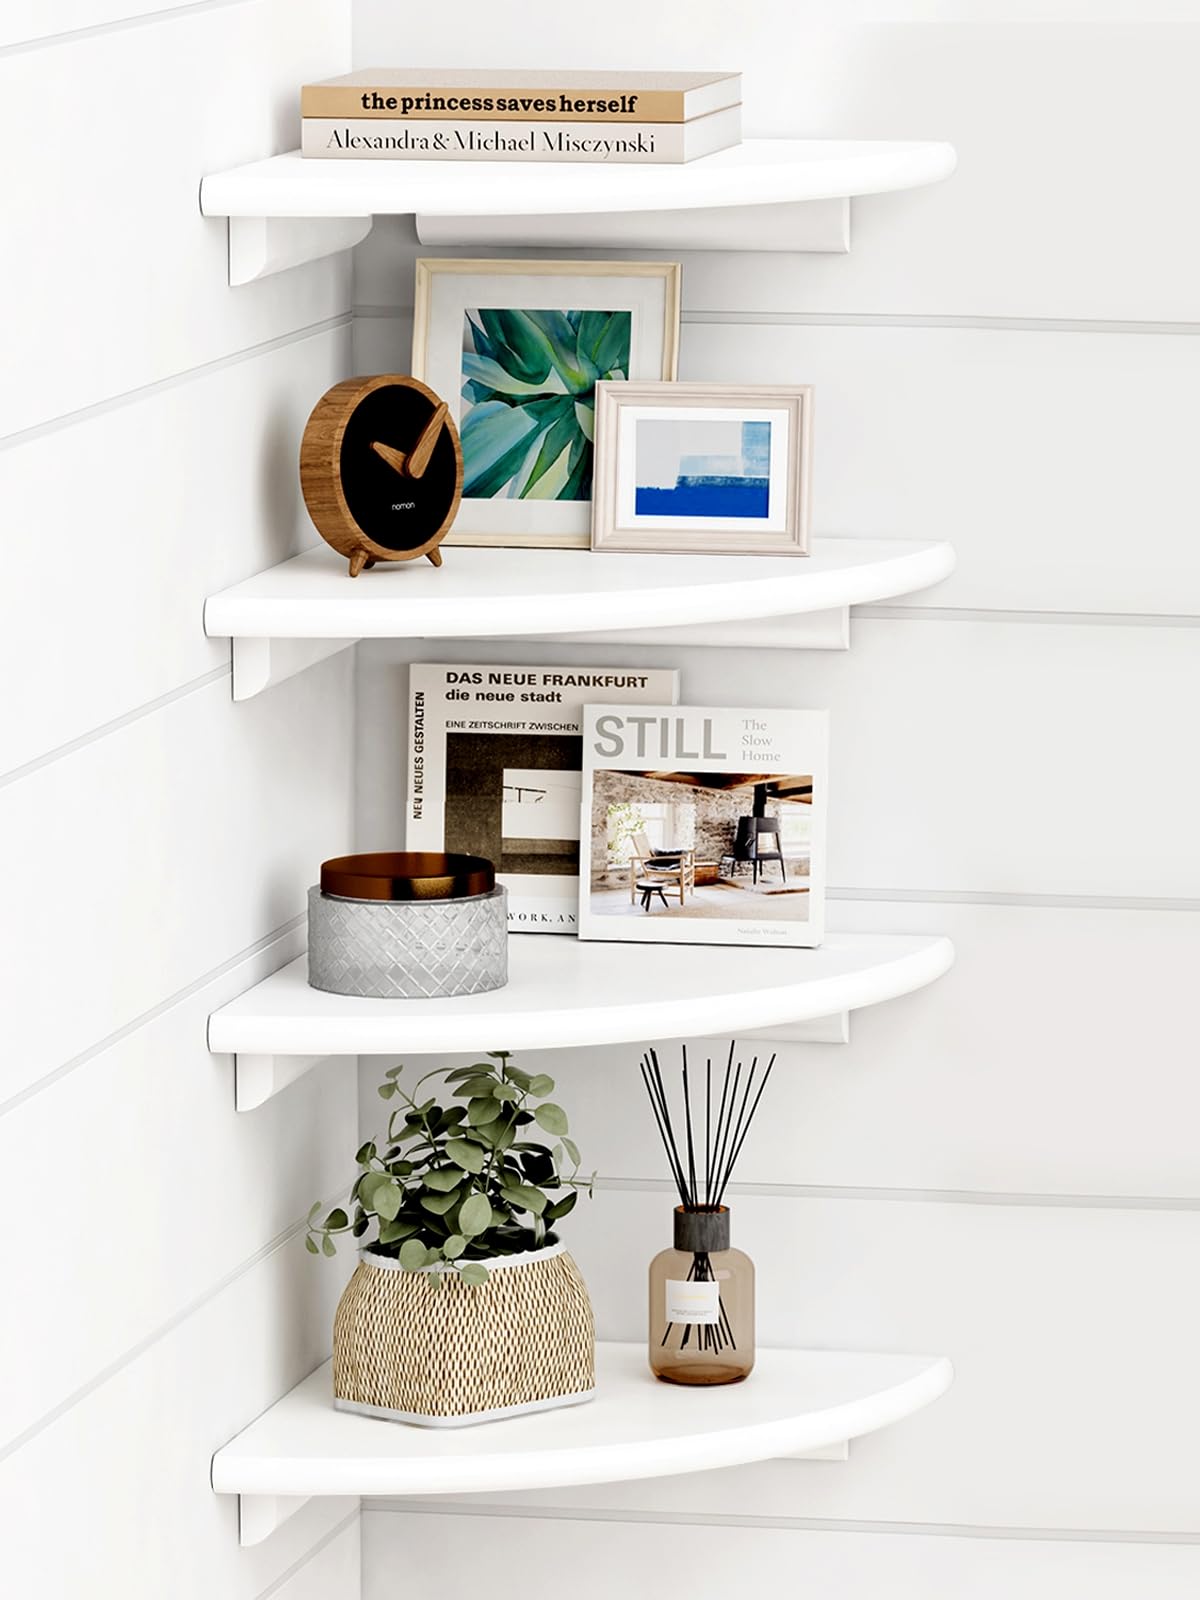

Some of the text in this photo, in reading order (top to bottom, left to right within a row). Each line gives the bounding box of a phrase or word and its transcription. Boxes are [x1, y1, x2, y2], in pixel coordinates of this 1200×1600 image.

[361, 91, 638, 115] the princess saves herself
[326, 128, 655, 160] Alexandra & Michael Misczynski
[391, 502, 416, 511] nomon
[446, 671, 649, 689] DAS NEUE FRANKFURT
[445, 689, 563, 703] die neue stadt
[414, 692, 425, 754] GESTALTEN
[445, 720, 580, 732] EINE ZEITSCHRIFT ZWISCHEN
[741, 719, 768, 732] The
[593, 715, 728, 760] STILL
[741, 734, 773, 748] Slow
[741, 750, 782, 762] Home
[414, 756, 424, 794] NEUES
